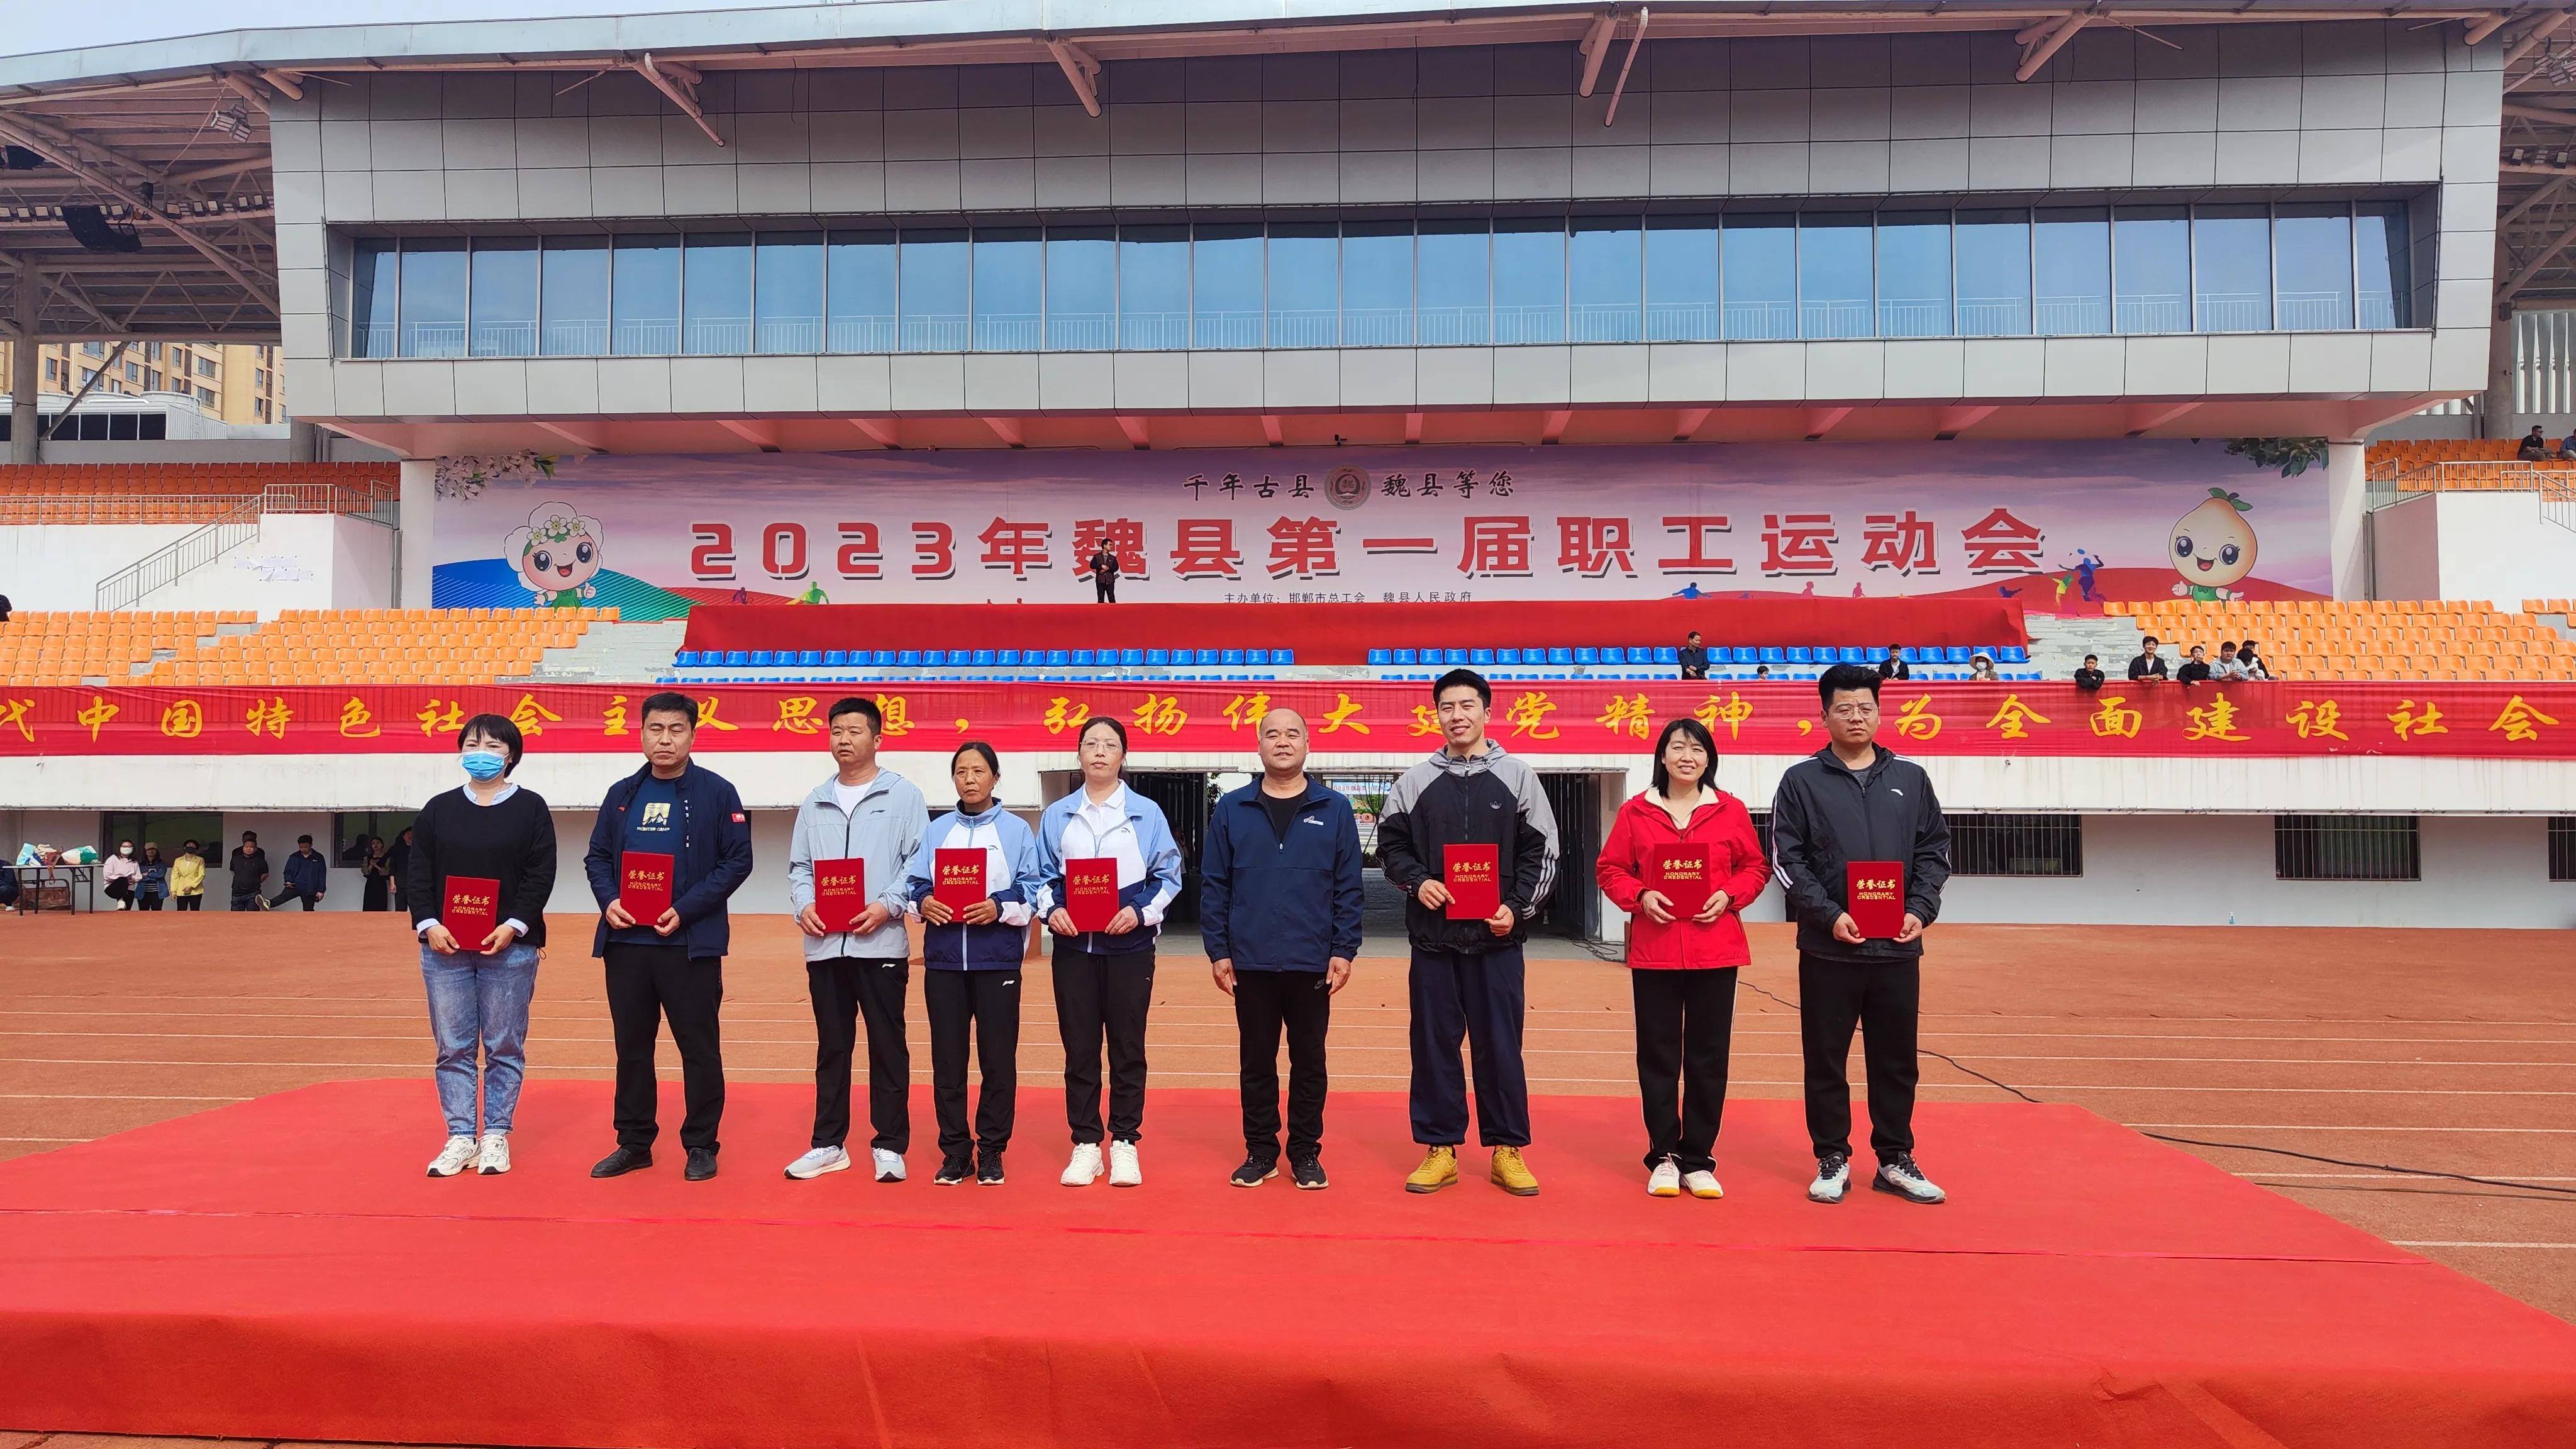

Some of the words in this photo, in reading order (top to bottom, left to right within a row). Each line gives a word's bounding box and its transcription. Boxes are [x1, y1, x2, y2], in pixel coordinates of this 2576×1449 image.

[1183, 473, 1314, 501] 千年古县
[1380, 469, 1514, 499] 魏县等您
[691, 508, 2045, 581] 2023年魏县第一届职工运动会
[1383, 591, 1472, 602] 魏县人民政府
[942, 864, 979, 875] 荣誉证书
[1452, 862, 1491, 872] 荣誉证书
[1663, 859, 1702, 870] 荣誉证书
[628, 869, 665, 881] 荣誉证书
[821, 875, 856, 886] 荣誉证书
[1073, 874, 1109, 885] 荣誉证书
[1857, 879, 1896, 890] 荣誉证书
[453, 894, 490, 906] 荣誉证书
